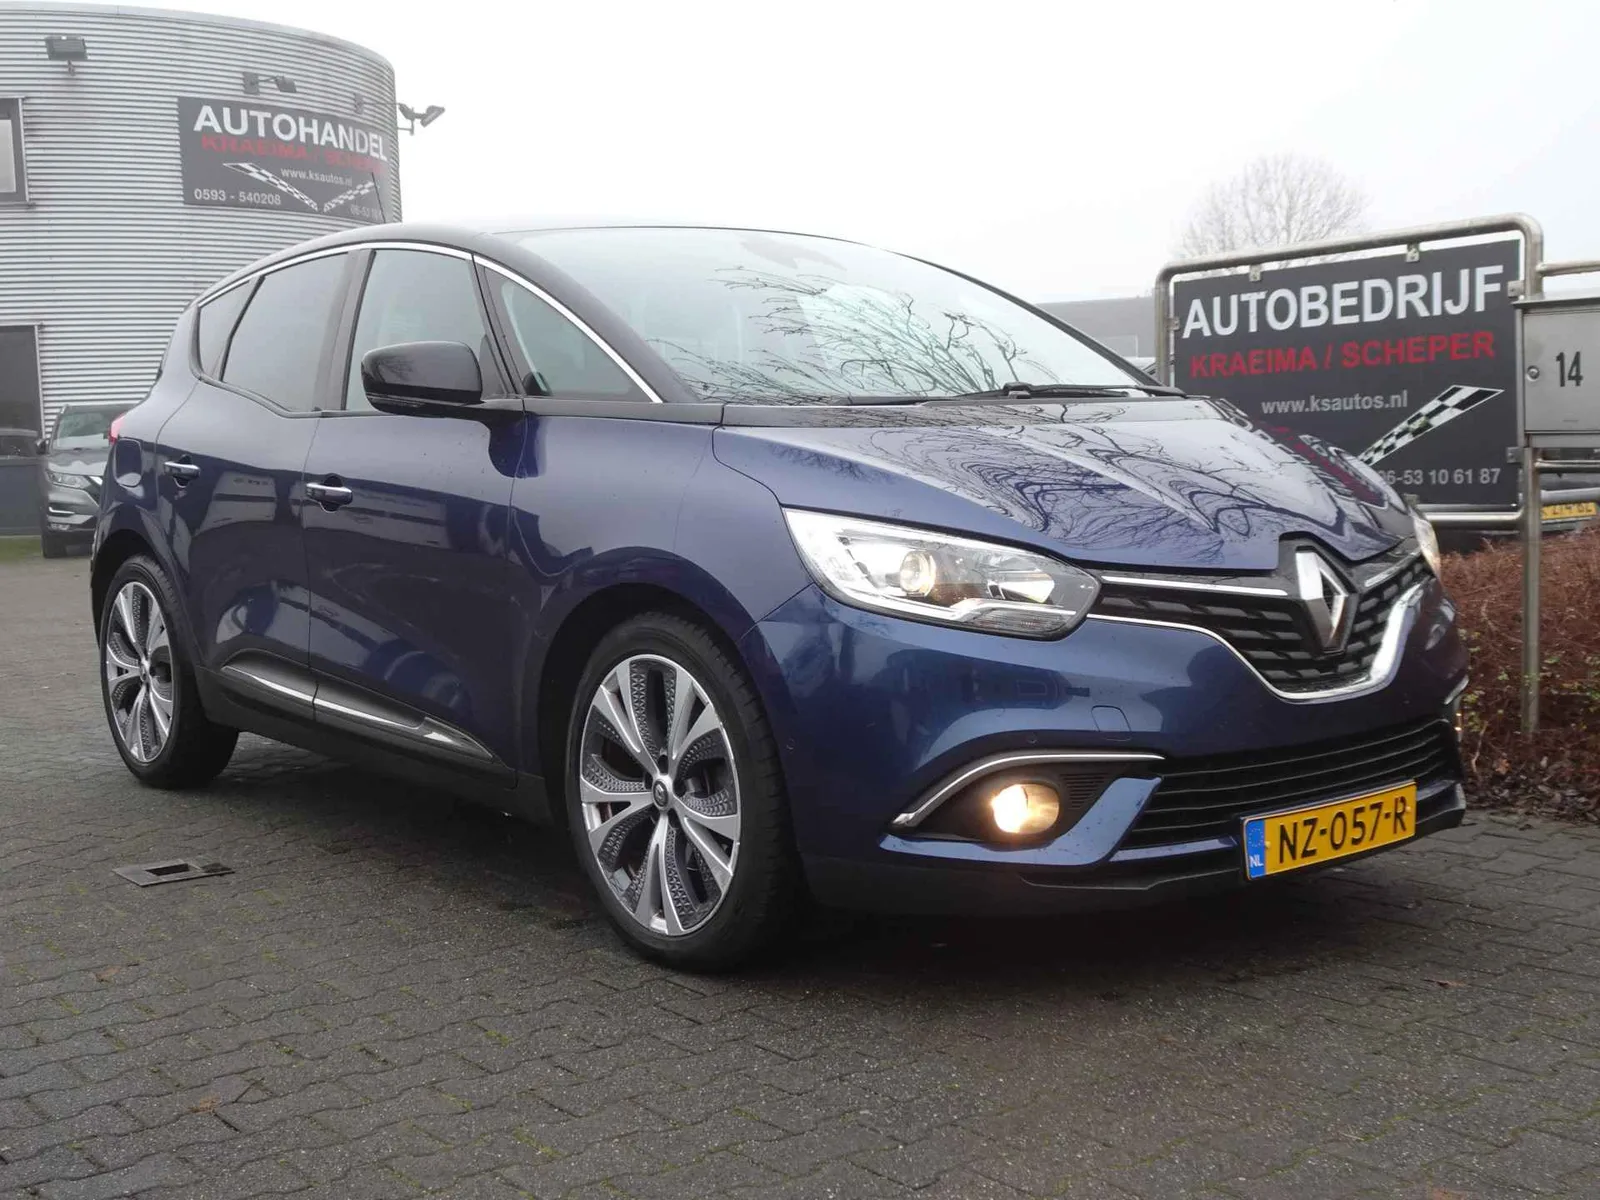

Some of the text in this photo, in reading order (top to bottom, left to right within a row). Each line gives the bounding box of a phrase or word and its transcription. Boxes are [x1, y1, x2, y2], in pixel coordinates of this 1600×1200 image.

[194, 105, 388, 161] AUTOHANDEL
[280, 167, 353, 186] www.ksautos.nl
[194, 188, 226, 201] 0593
[239, 190, 282, 205] 540208
[1182, 264, 1504, 339] AUTOBEDRIJF
[1189, 331, 1496, 379] KRAEIMA / SCHEPER
[1556, 351, 1583, 388] 14
[1261, 390, 1408, 415] www.ksautos.nl
[1428, 469, 1449, 485] 10
[1453, 468, 1473, 485] 61
[1479, 467, 1501, 484] 87
[1278, 796, 1407, 864] NZ-057-R
[1250, 854, 1264, 868] NL
